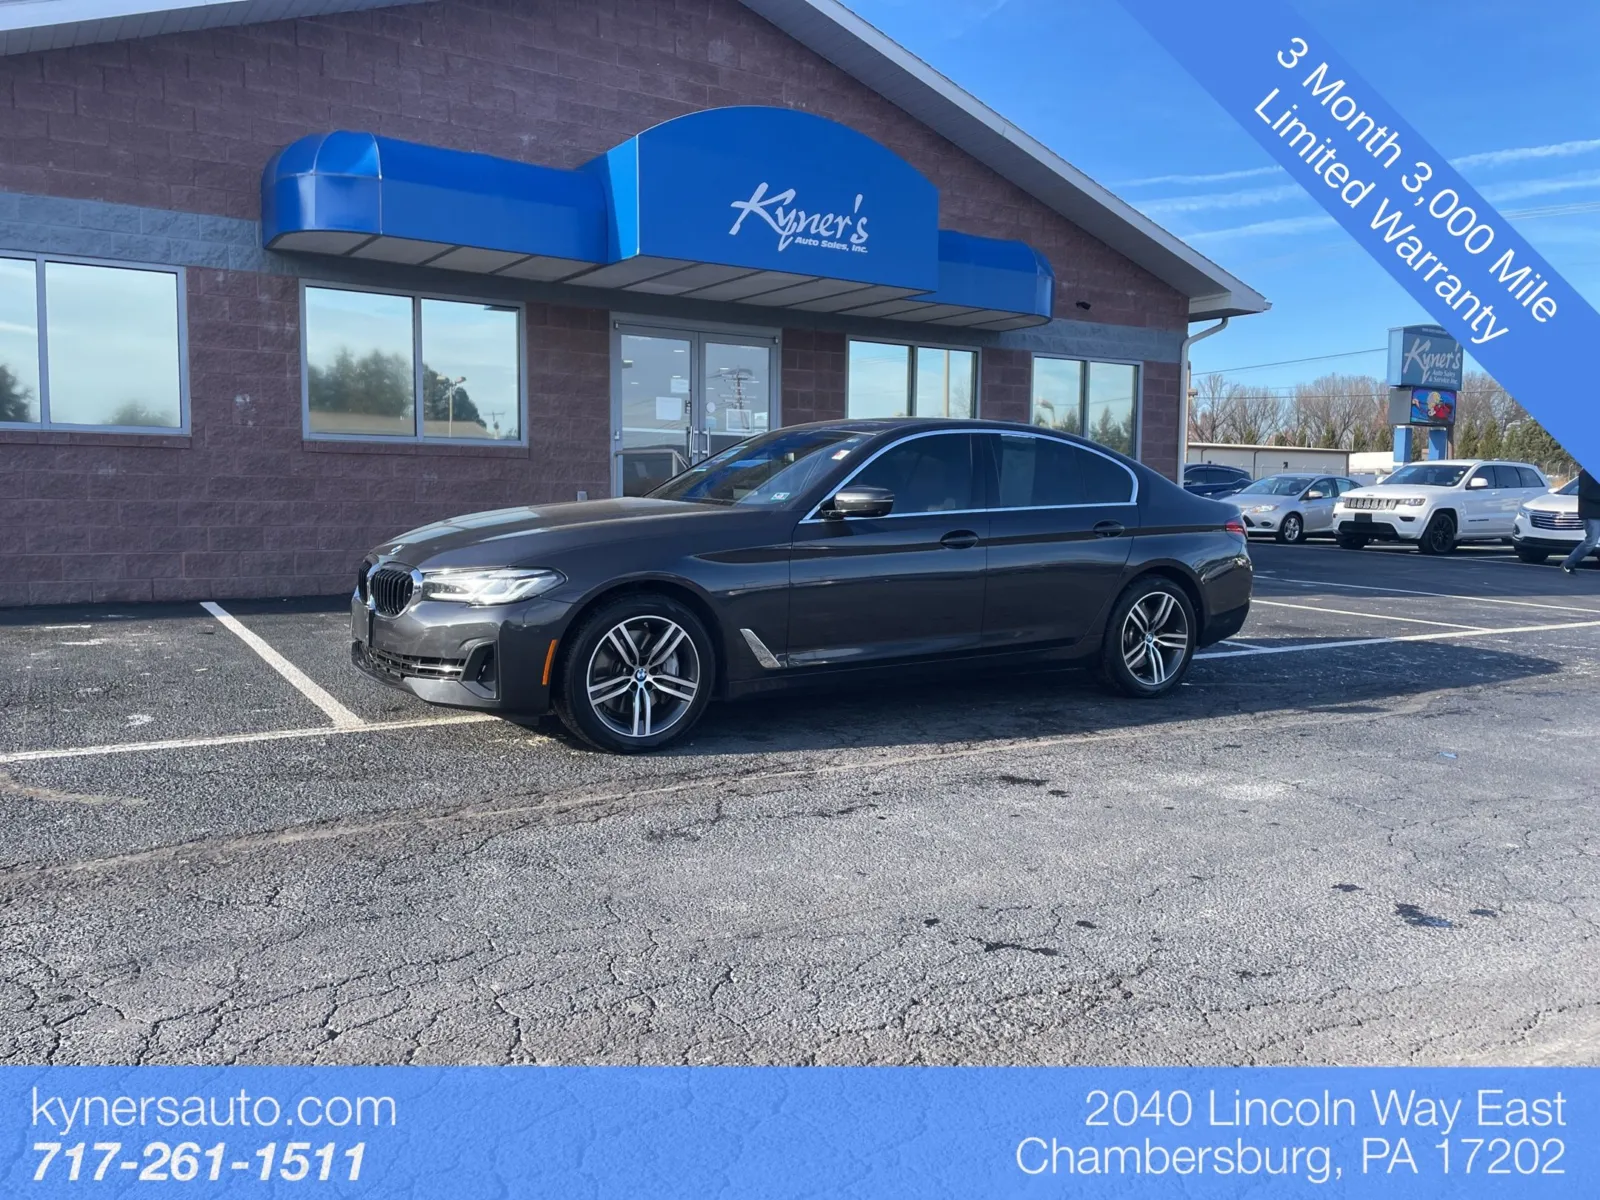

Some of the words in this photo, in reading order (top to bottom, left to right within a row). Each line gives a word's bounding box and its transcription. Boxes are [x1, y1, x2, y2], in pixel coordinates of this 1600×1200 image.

[728, 181, 869, 252] Kyner's
[795, 236, 819, 247] Auto
[820, 239, 849, 252] Sales,
[851, 243, 869, 254] Inc.
[1402, 337, 1461, 385] Kyner's
